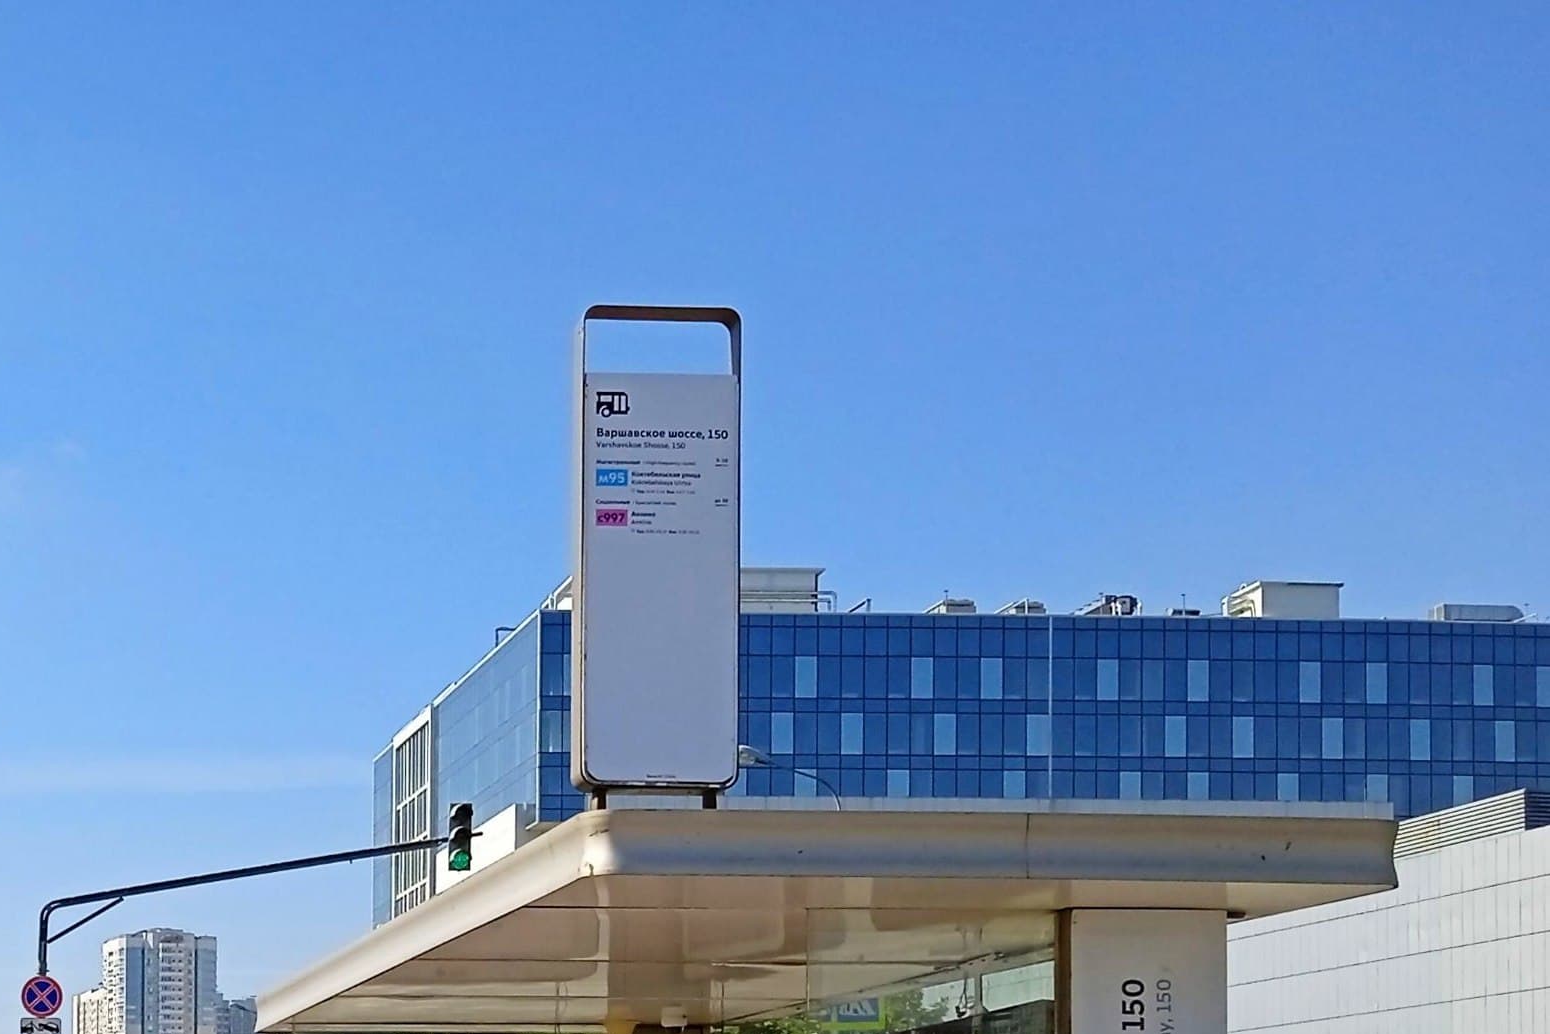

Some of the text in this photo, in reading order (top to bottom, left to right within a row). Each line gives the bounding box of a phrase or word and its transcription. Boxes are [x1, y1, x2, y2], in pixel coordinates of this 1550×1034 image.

[596, 427, 729, 441] Варшавское шоссе, 150
[1121, 979, 1145, 1031] 150
[1156, 979, 1172, 1012] 150
